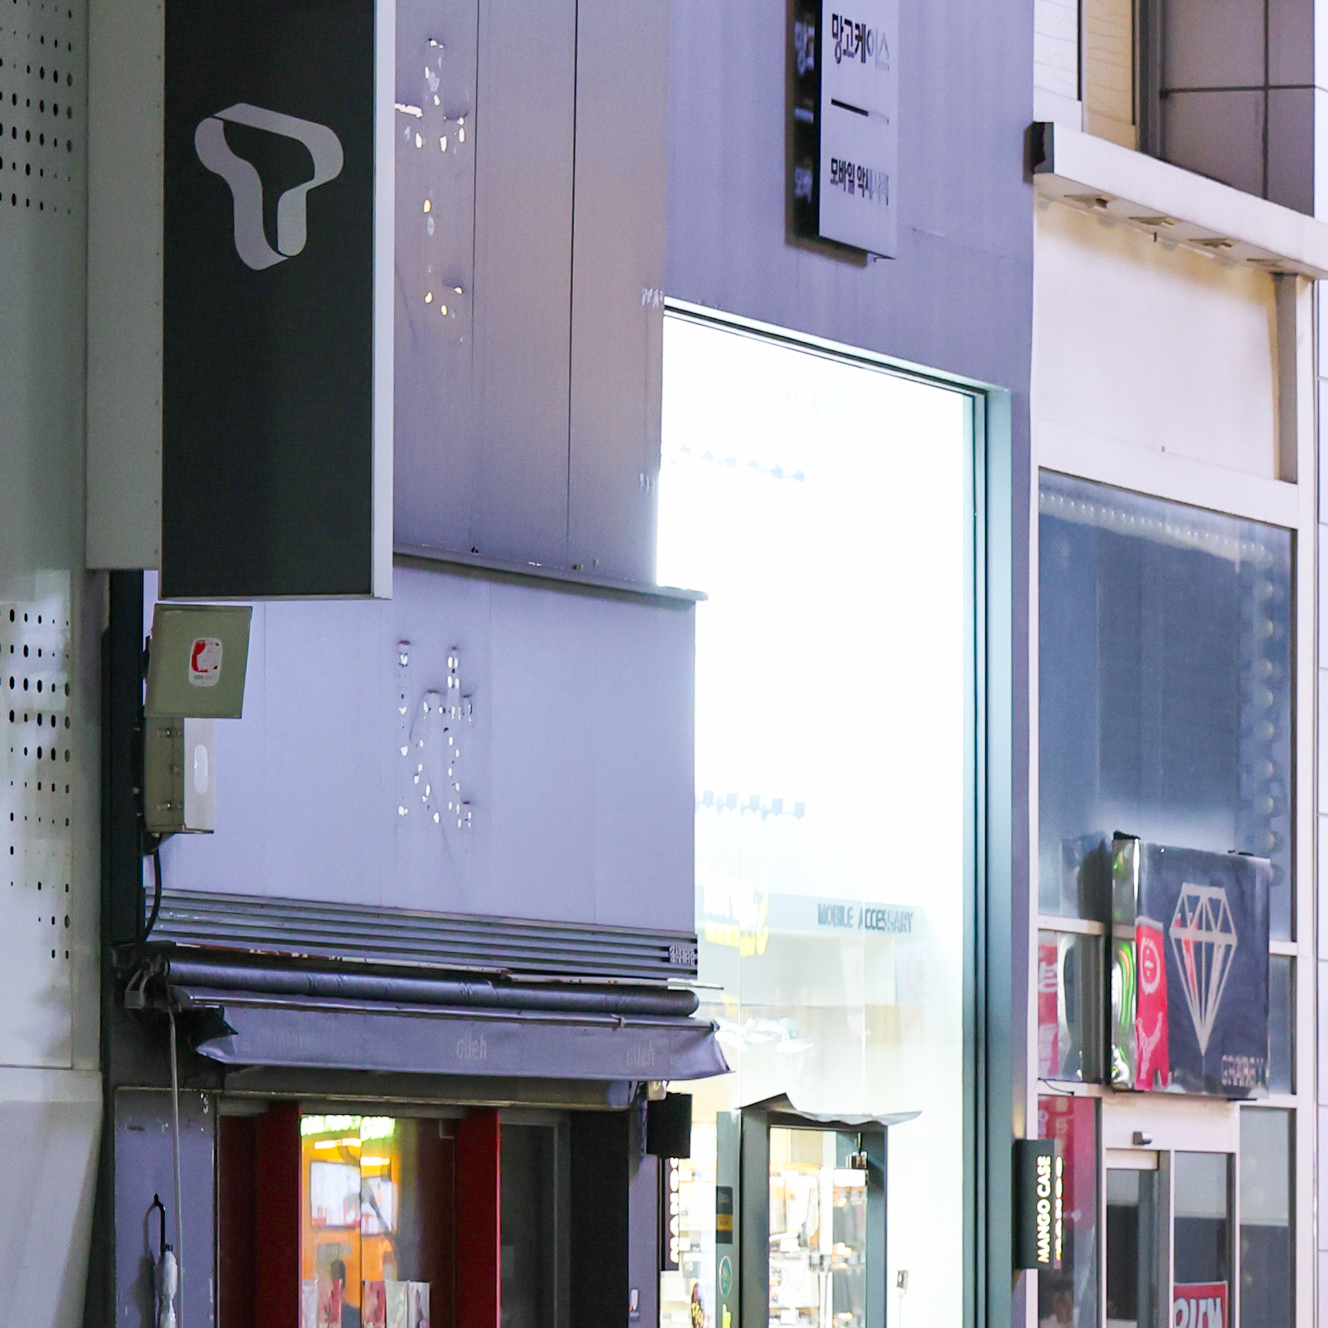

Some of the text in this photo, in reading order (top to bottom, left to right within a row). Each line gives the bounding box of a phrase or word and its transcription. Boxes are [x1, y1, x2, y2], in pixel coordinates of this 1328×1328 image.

[817, 903, 854, 927] MOBILE
[1036, 1155, 1051, 1263] MANGO CASE
